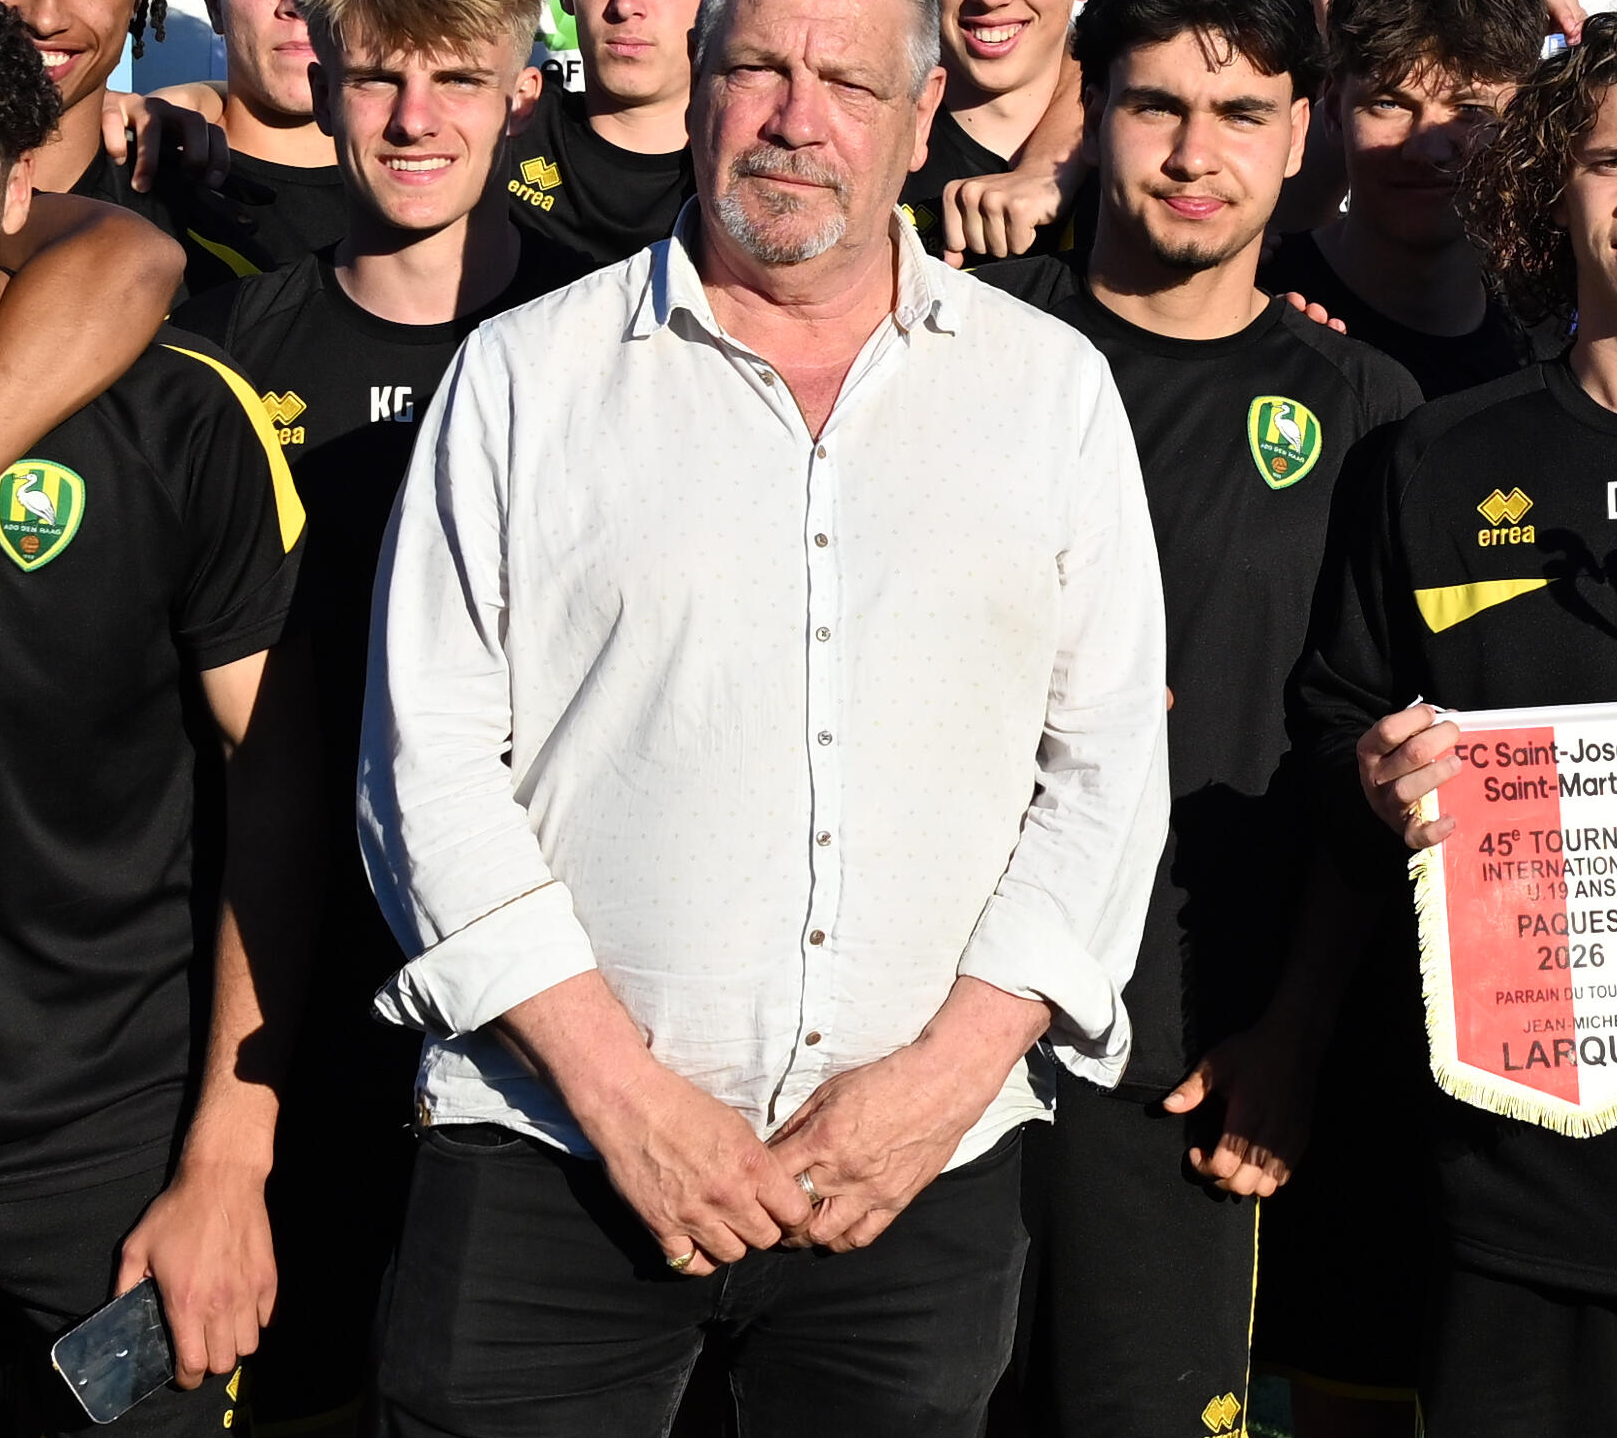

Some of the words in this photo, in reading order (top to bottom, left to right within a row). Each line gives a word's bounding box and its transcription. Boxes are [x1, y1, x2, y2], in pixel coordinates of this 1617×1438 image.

[506, 179, 555, 212] errea
[370, 386, 414, 423] KG
[1477, 525, 1536, 547] errea
[1453, 744, 1488, 769] FC
[1574, 878, 1617, 899] ANS
[1537, 943, 1605, 971] 2026
[1495, 988, 1560, 1005] PARRAIN
[1563, 986, 1584, 1001] DU
